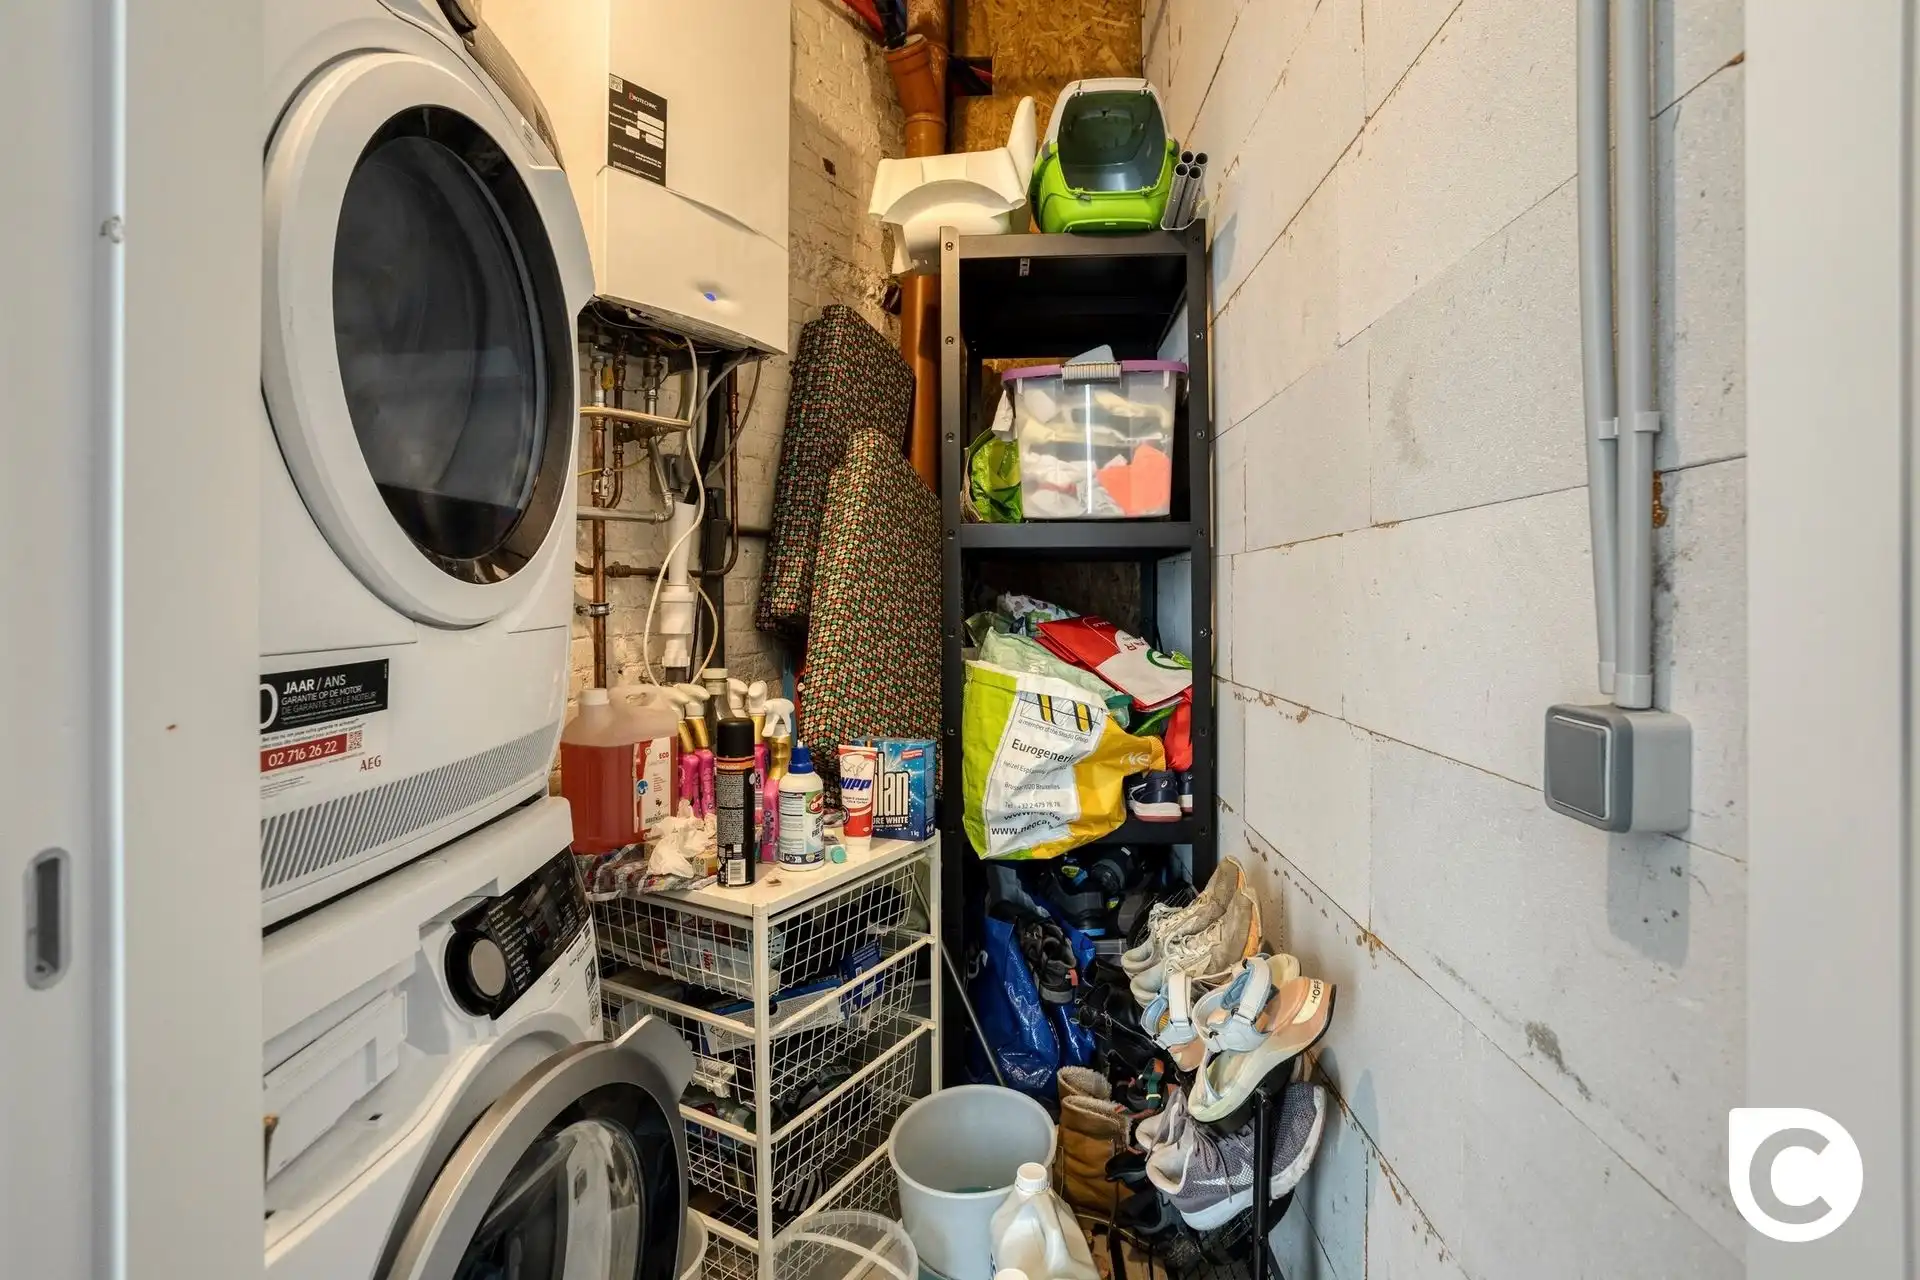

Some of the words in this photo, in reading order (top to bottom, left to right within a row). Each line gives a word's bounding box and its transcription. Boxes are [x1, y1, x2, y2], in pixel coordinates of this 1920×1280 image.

[283, 679, 314, 695] JAAR
[324, 674, 346, 687] ANS
[281, 692, 317, 705] GARANTIE
[318, 690, 328, 699] OP
[329, 689, 338, 697] DE
[281, 706, 291, 715] DE
[293, 700, 328, 713] GARANTIE
[268, 752, 284, 767] 02
[287, 748, 306, 763] 716
[308, 744, 321, 758] 26
[324, 740, 337, 754] 22
[359, 755, 382, 772] AEG
[885, 816, 909, 824] WHITE
